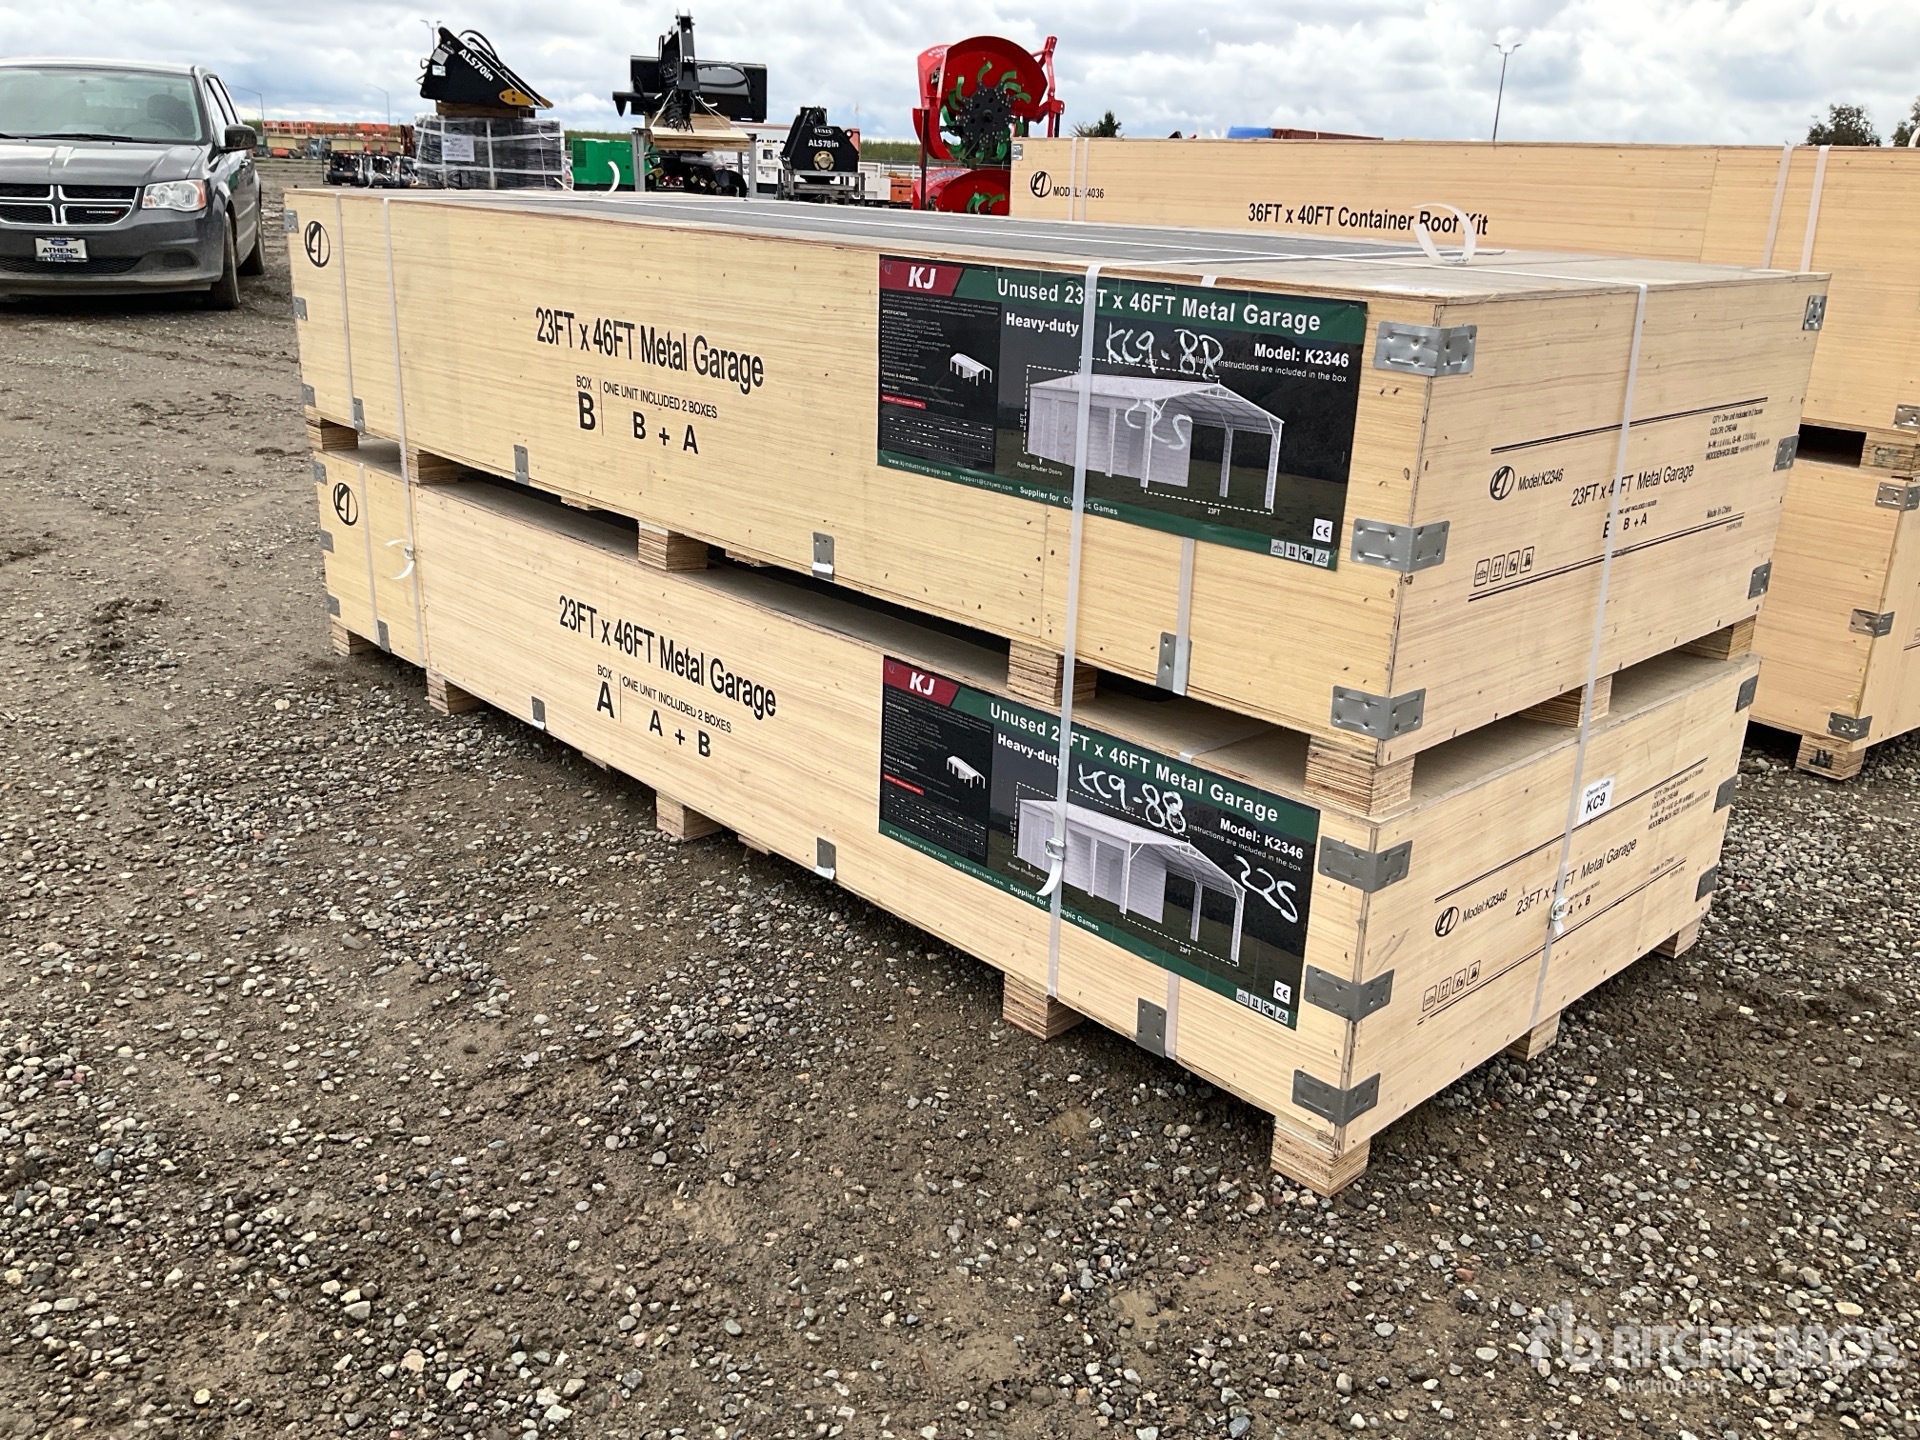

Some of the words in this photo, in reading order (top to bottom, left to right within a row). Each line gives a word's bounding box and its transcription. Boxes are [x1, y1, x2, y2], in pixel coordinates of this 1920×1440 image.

[458, 49, 494, 82] ALS70in
[808, 139, 839, 148] ALS78in
[1248, 203, 1283, 222] 36FT
[1285, 209, 1294, 224] x
[1298, 205, 1334, 226] 40FT
[1338, 207, 1414, 231] Container
[908, 266, 936, 290] KJ
[997, 278, 1058, 302] Unused
[1064, 286, 1108, 308] 23T
[1112, 294, 1123, 310] x
[1130, 292, 1176, 315] 46FT
[1182, 298, 1236, 322] Metal
[1243, 304, 1320, 334] Garage
[1006, 312, 1080, 338] Heavy-duty
[536, 306, 575, 348] 23FT
[579, 323, 590, 352] x
[592, 318, 636, 360] 46FT
[640, 325, 688, 372] Metal
[693, 334, 764, 394] Garage
[1254, 343, 1300, 362] Model:
[1305, 349, 1350, 368] K2346
[576, 375, 593, 390] BOX
[1218, 360, 1259, 372] instructions
[1274, 366, 1306, 378] included
[1308, 371, 1316, 379] in
[1318, 372, 1330, 380] the
[1332, 374, 1348, 383] box
[578, 391, 596, 430] B
[603, 382, 620, 396] ONE
[622, 386, 638, 401] UNIT
[640, 390, 680, 410] INCLUDED
[682, 400, 688, 412] 2
[689, 402, 718, 418] BOXES
[633, 411, 646, 440] B
[682, 424, 699, 454] A
[1016, 461, 1030, 470] Roller
[1031, 464, 1048, 474] Shutter
[1049, 466, 1062, 476] Doors
[1518, 468, 1564, 491] Model:K2346
[1571, 483, 1600, 506] 23FT
[1599, 486, 1606, 500] x
[1608, 474, 1634, 498] 4FT
[1637, 468, 1662, 490] Metal
[1664, 464, 1694, 487] Garage
[1020, 486, 1047, 500] Supplier
[1050, 493, 1059, 502] for
[1094, 502, 1118, 515] Games
[1208, 507, 1220, 516] 23FT
[1623, 518, 1630, 530] B
[1640, 512, 1647, 526] A
[560, 595, 597, 638] 23FT
[601, 619, 610, 646] x
[614, 619, 654, 664] 46FT
[660, 635, 704, 686] Metal
[710, 658, 776, 720] Garage
[598, 664, 612, 681] BOX
[596, 681, 615, 719] A
[909, 671, 936, 696] KJ
[622, 676, 638, 694] ONE
[640, 684, 656, 700] UNIT
[658, 692, 696, 718] INCLUDED
[698, 709, 704, 721] 2
[704, 712, 732, 734] BOXES
[649, 710, 664, 736] A
[698, 730, 710, 758] B
[990, 702, 1046, 736] Unused
[1051, 725, 1090, 751] 2FT
[1094, 744, 1104, 758] x
[1109, 748, 1150, 774] 46FT
[1156, 763, 1203, 794] Metal
[1210, 784, 1278, 822] Garage
[1586, 792, 1606, 814] KC9
[1188, 824, 1225, 842] instructions
[1226, 838, 1237, 846] are
[1238, 840, 1267, 858] included
[1276, 856, 1288, 867] the
[1288, 859, 1302, 872] box
[1220, 818, 1260, 844] Model:
[1264, 834, 1304, 860] K2346
[1516, 888, 1543, 916] 23FT
[1544, 888, 1550, 900] x
[1552, 869, 1577, 896] 4FT
[1580, 854, 1605, 880] Metal
[1606, 838, 1637, 864] Garage
[1010, 884, 1036, 902] Supplier
[1037, 896, 1046, 906] for
[1078, 916, 1099, 931] Games
[1462, 888, 1508, 922] Model:K2346
[1568, 904, 1574, 916] A
[1585, 894, 1591, 905] B
